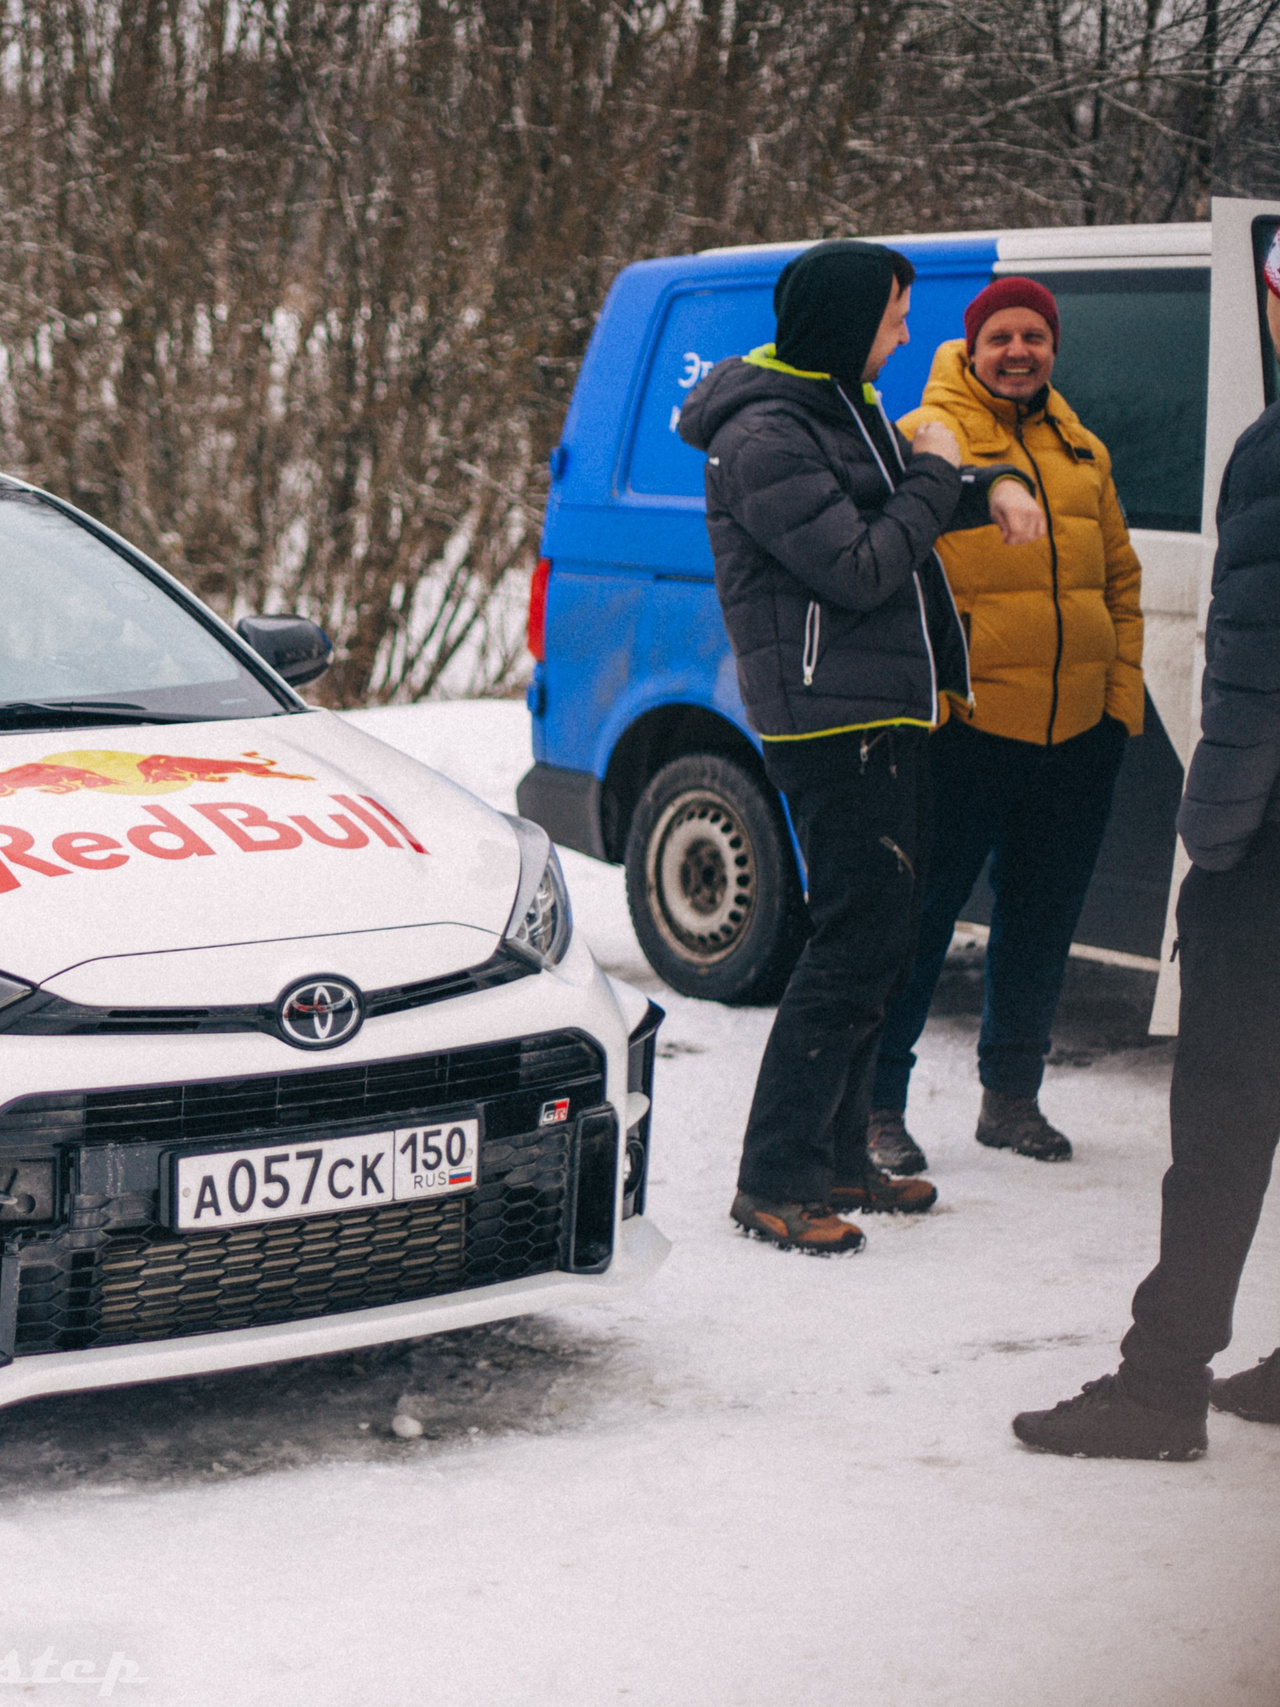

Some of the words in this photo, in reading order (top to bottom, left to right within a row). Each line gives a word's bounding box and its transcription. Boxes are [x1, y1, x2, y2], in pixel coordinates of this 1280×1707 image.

[189, 794, 432, 855] Bull
[400, 1127, 466, 1173] 150
[413, 1171, 448, 1189] RUS
